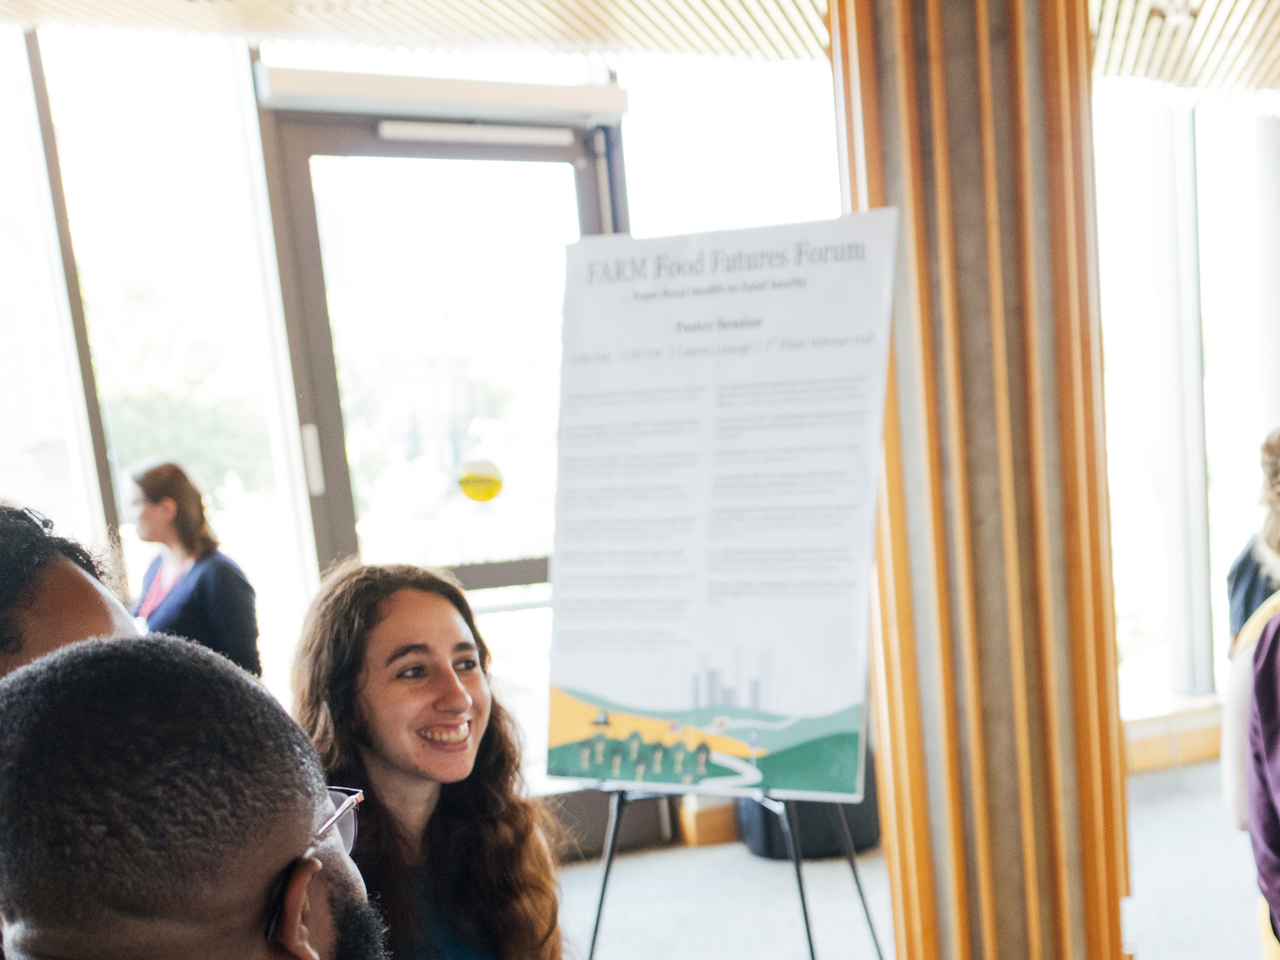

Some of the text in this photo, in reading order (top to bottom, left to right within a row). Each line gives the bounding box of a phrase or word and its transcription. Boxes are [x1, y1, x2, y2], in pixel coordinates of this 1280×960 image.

[587, 238, 867, 286] FARM Food Futures Forum
[717, 315, 764, 331] Session
